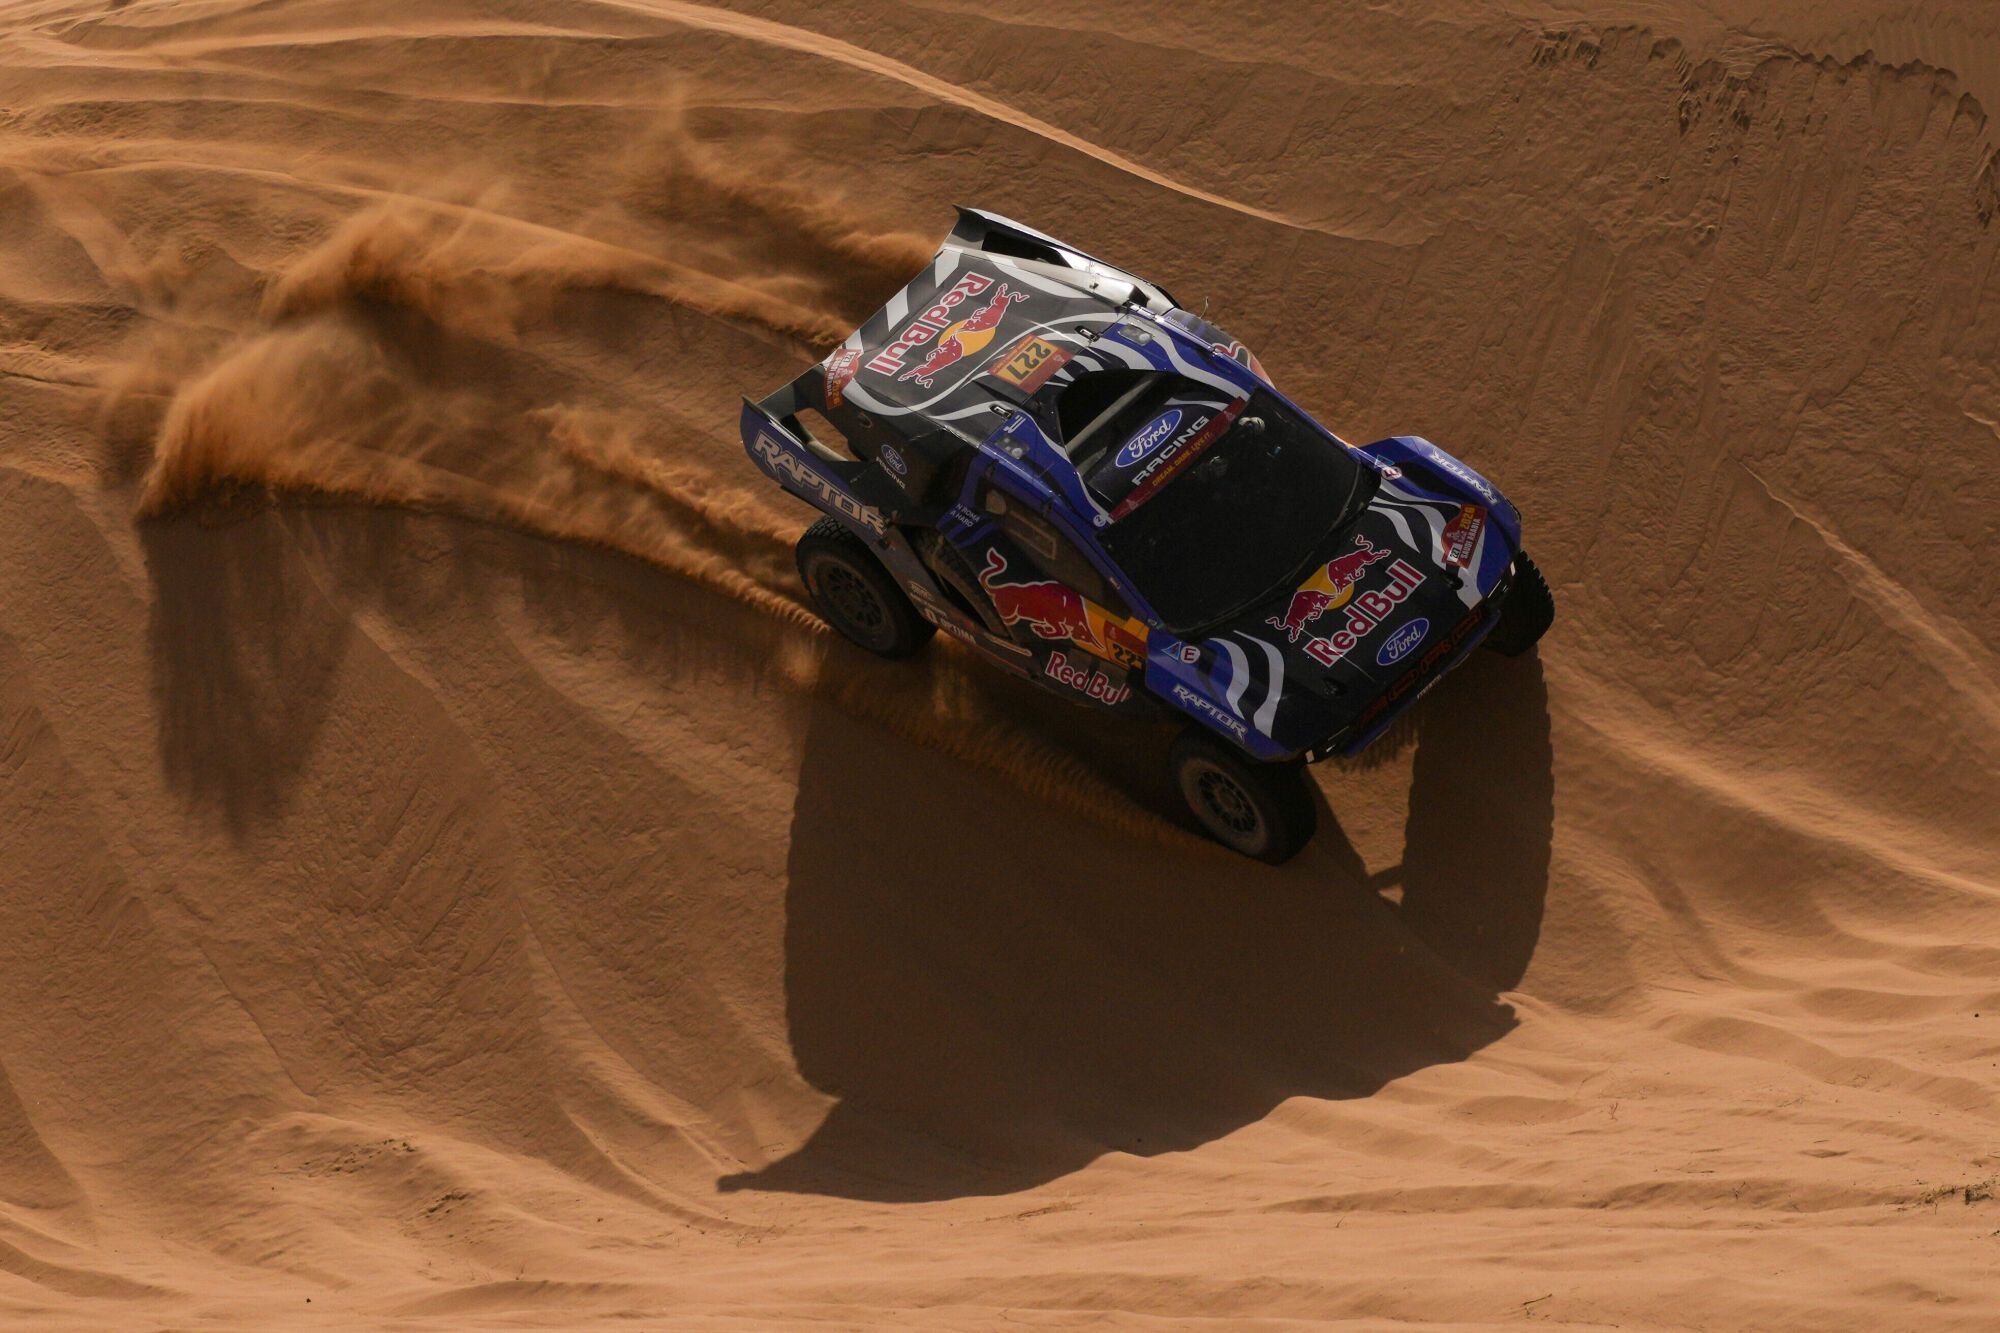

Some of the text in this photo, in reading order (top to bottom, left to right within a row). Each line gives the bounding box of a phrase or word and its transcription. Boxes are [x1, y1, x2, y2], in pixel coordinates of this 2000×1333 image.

[1007, 342, 1052, 380] 227
[1128, 418, 1172, 459] Ford
[1131, 415, 1210, 486] RACING
[752, 430, 887, 535] RAPTOR
[875, 455, 906, 489] RACING
[1429, 449, 1498, 505] RAPTOR
[955, 513, 975, 527] HARO
[961, 506, 981, 522] ROMA
[1460, 518, 1481, 559] SAUDI ARABIA
[1183, 647, 1197, 661] E
[1386, 625, 1421, 659] Ford
[1172, 682, 1249, 744] RAPTOR
